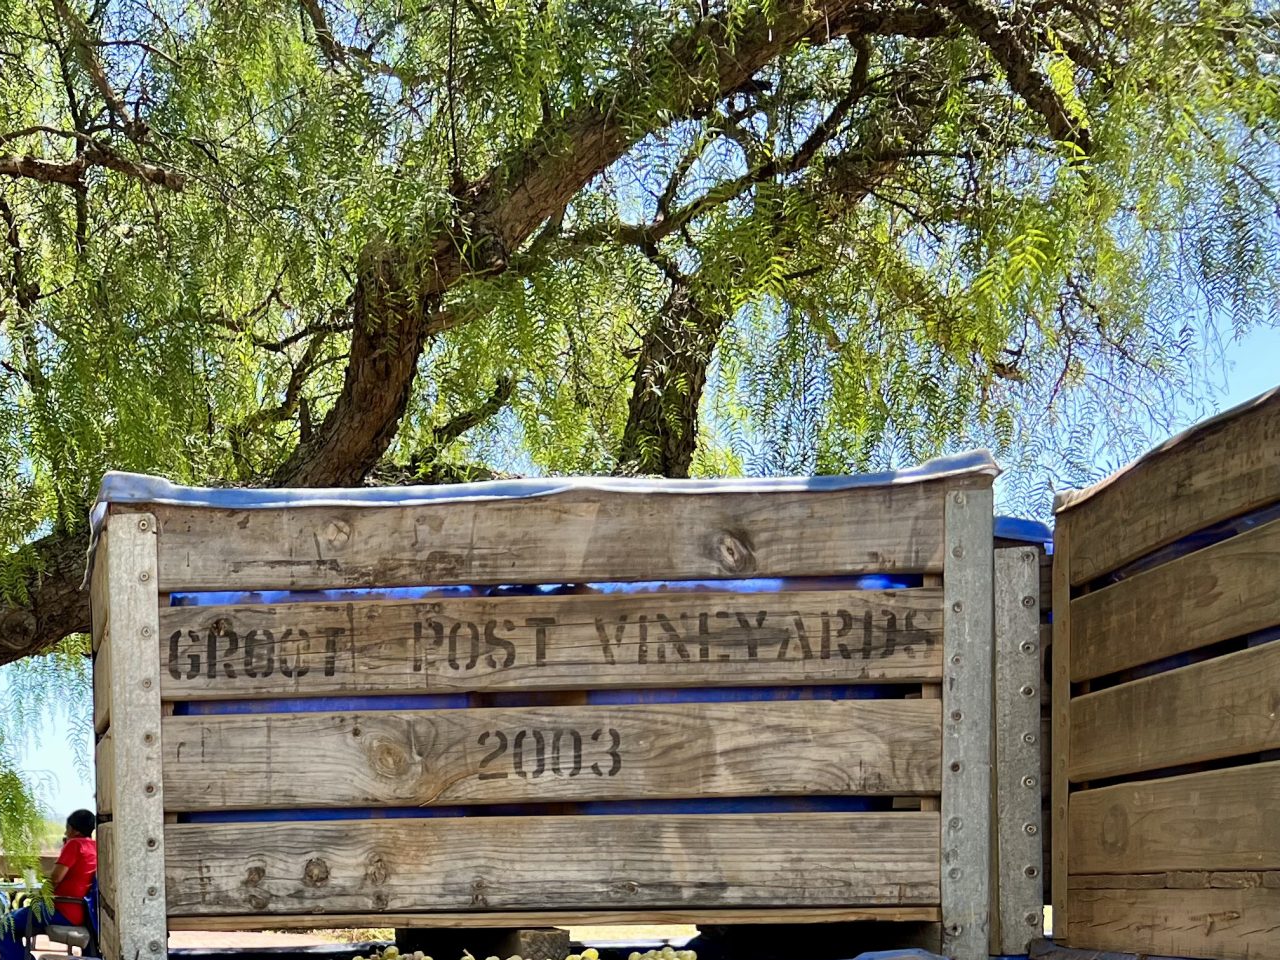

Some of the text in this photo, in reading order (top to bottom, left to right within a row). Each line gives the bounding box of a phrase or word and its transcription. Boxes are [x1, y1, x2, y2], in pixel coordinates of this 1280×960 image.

[413, 616, 557, 673] POST
[593, 608, 936, 666] VINEYARDS
[477, 727, 623, 780] 2003
